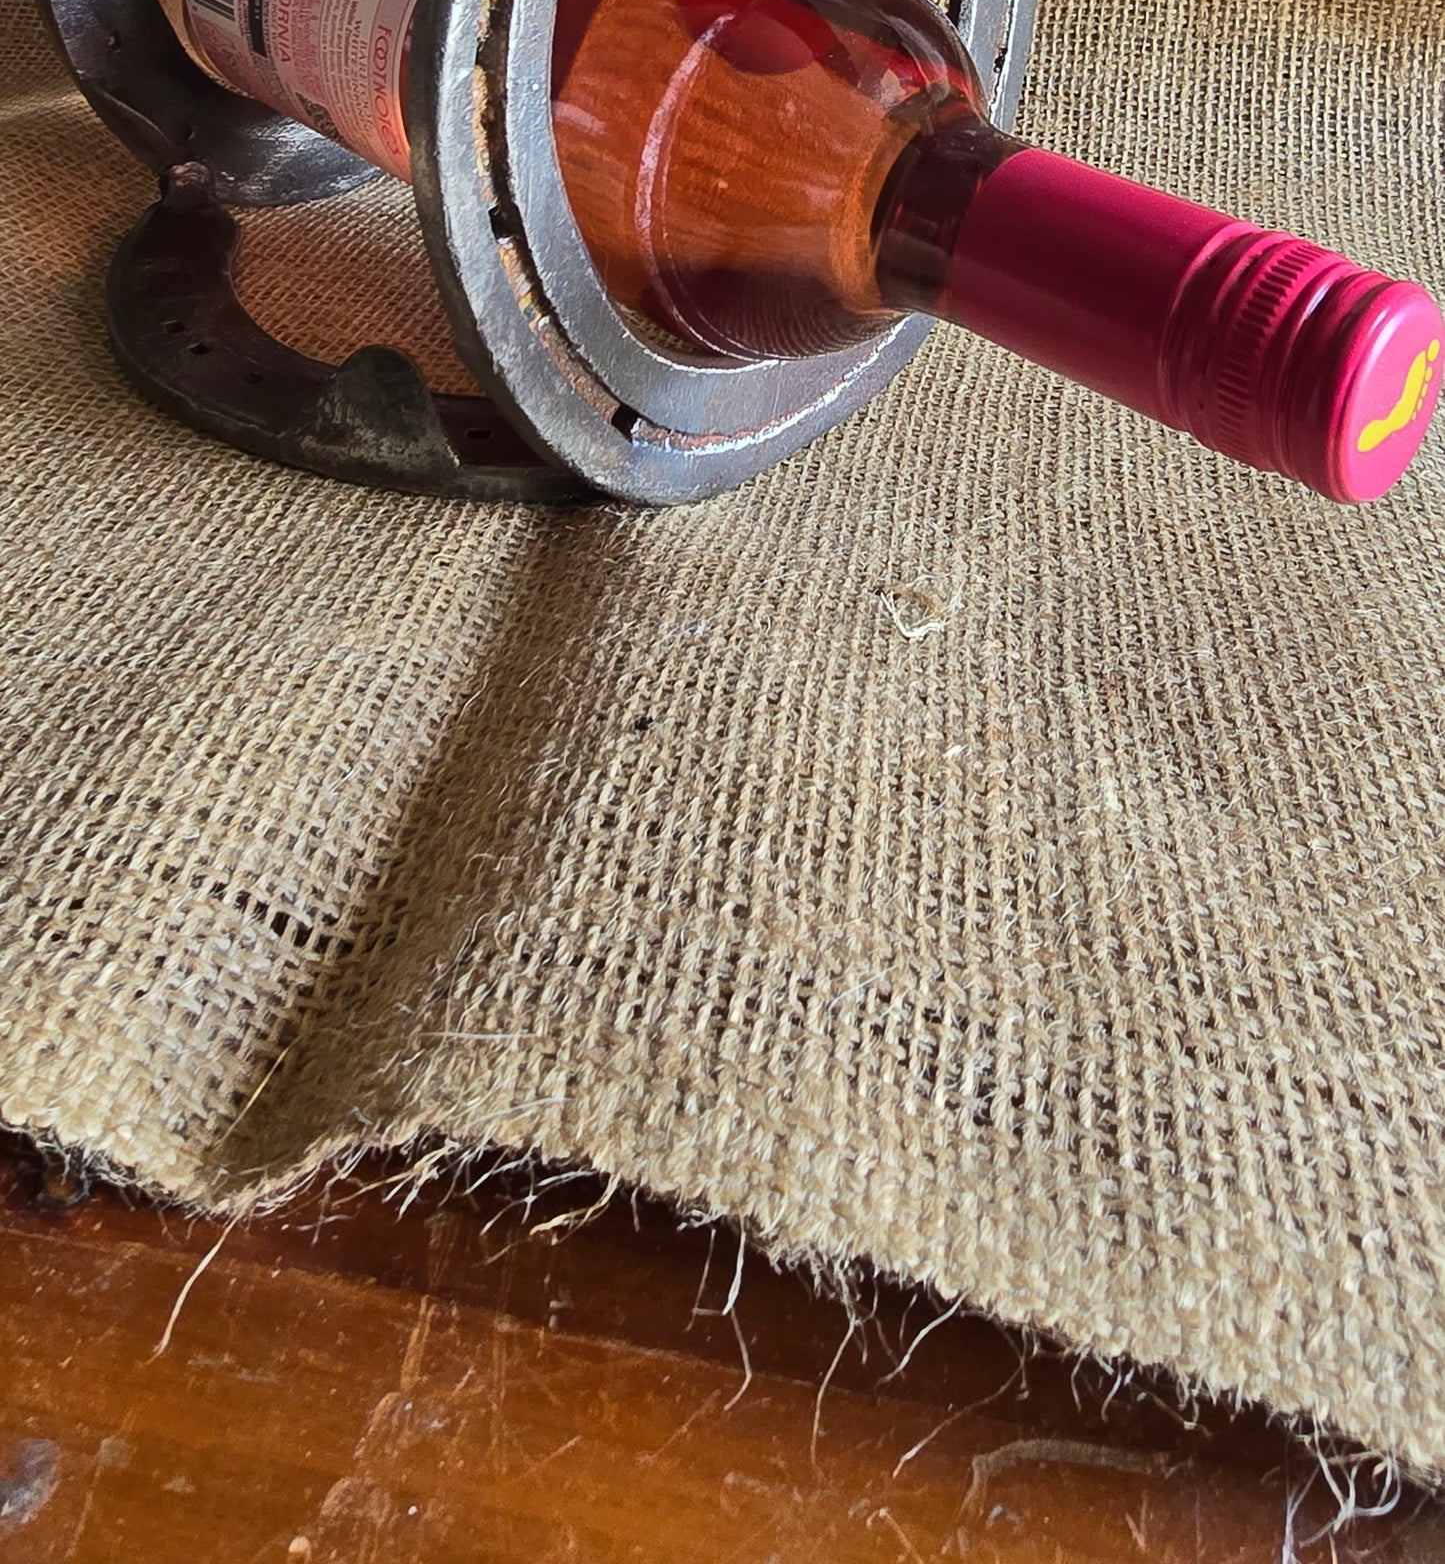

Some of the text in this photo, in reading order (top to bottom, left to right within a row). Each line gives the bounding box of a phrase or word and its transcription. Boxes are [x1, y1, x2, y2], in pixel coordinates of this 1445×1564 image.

[347, 0, 357, 26] White
[350, 17, 362, 64] WHITE
[373, 24, 402, 157] FOOTNOTES
